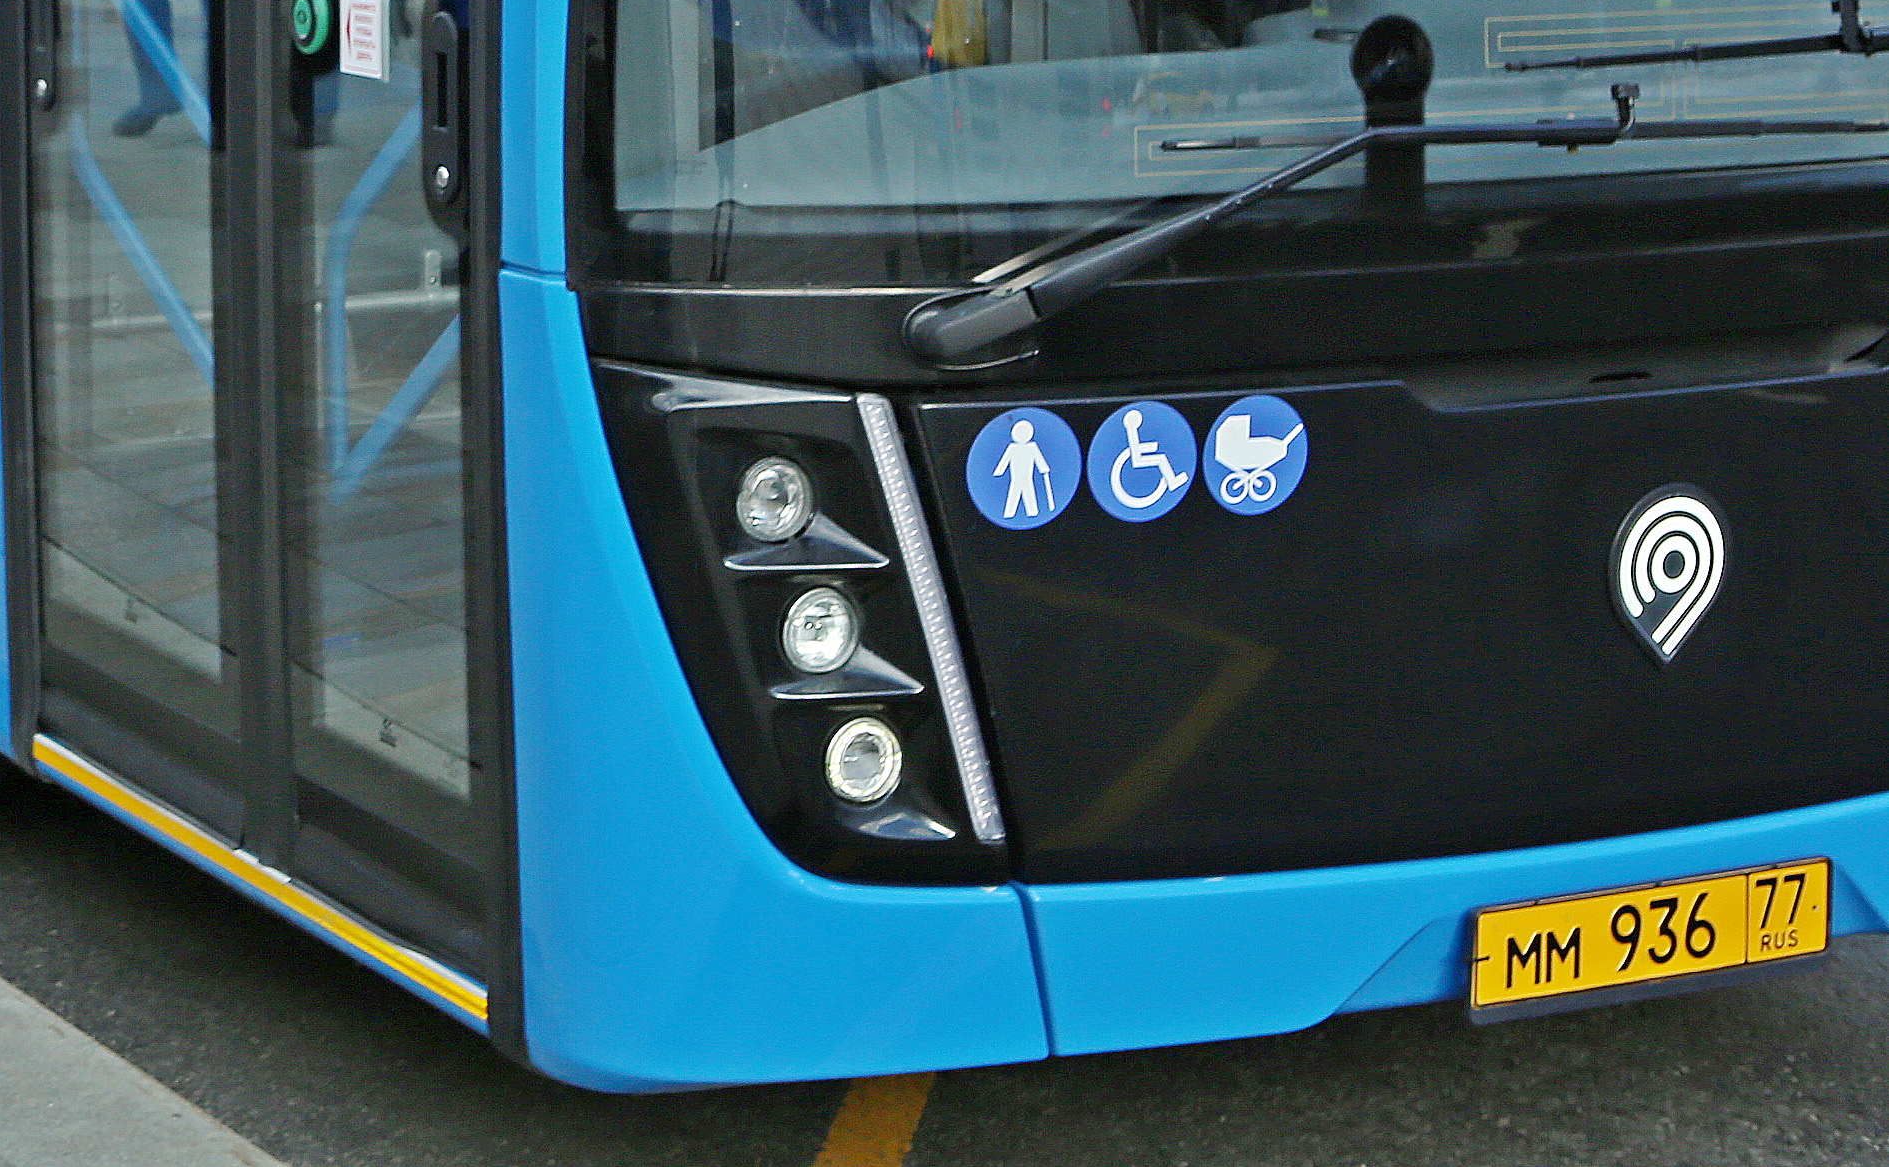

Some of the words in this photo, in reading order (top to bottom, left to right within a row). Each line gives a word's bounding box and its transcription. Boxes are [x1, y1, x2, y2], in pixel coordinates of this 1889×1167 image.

[1506, 926, 1581, 989] ММ
[1610, 892, 1717, 973] 936
[1755, 873, 1807, 931] 77
[1759, 928, 1800, 953] RUS
